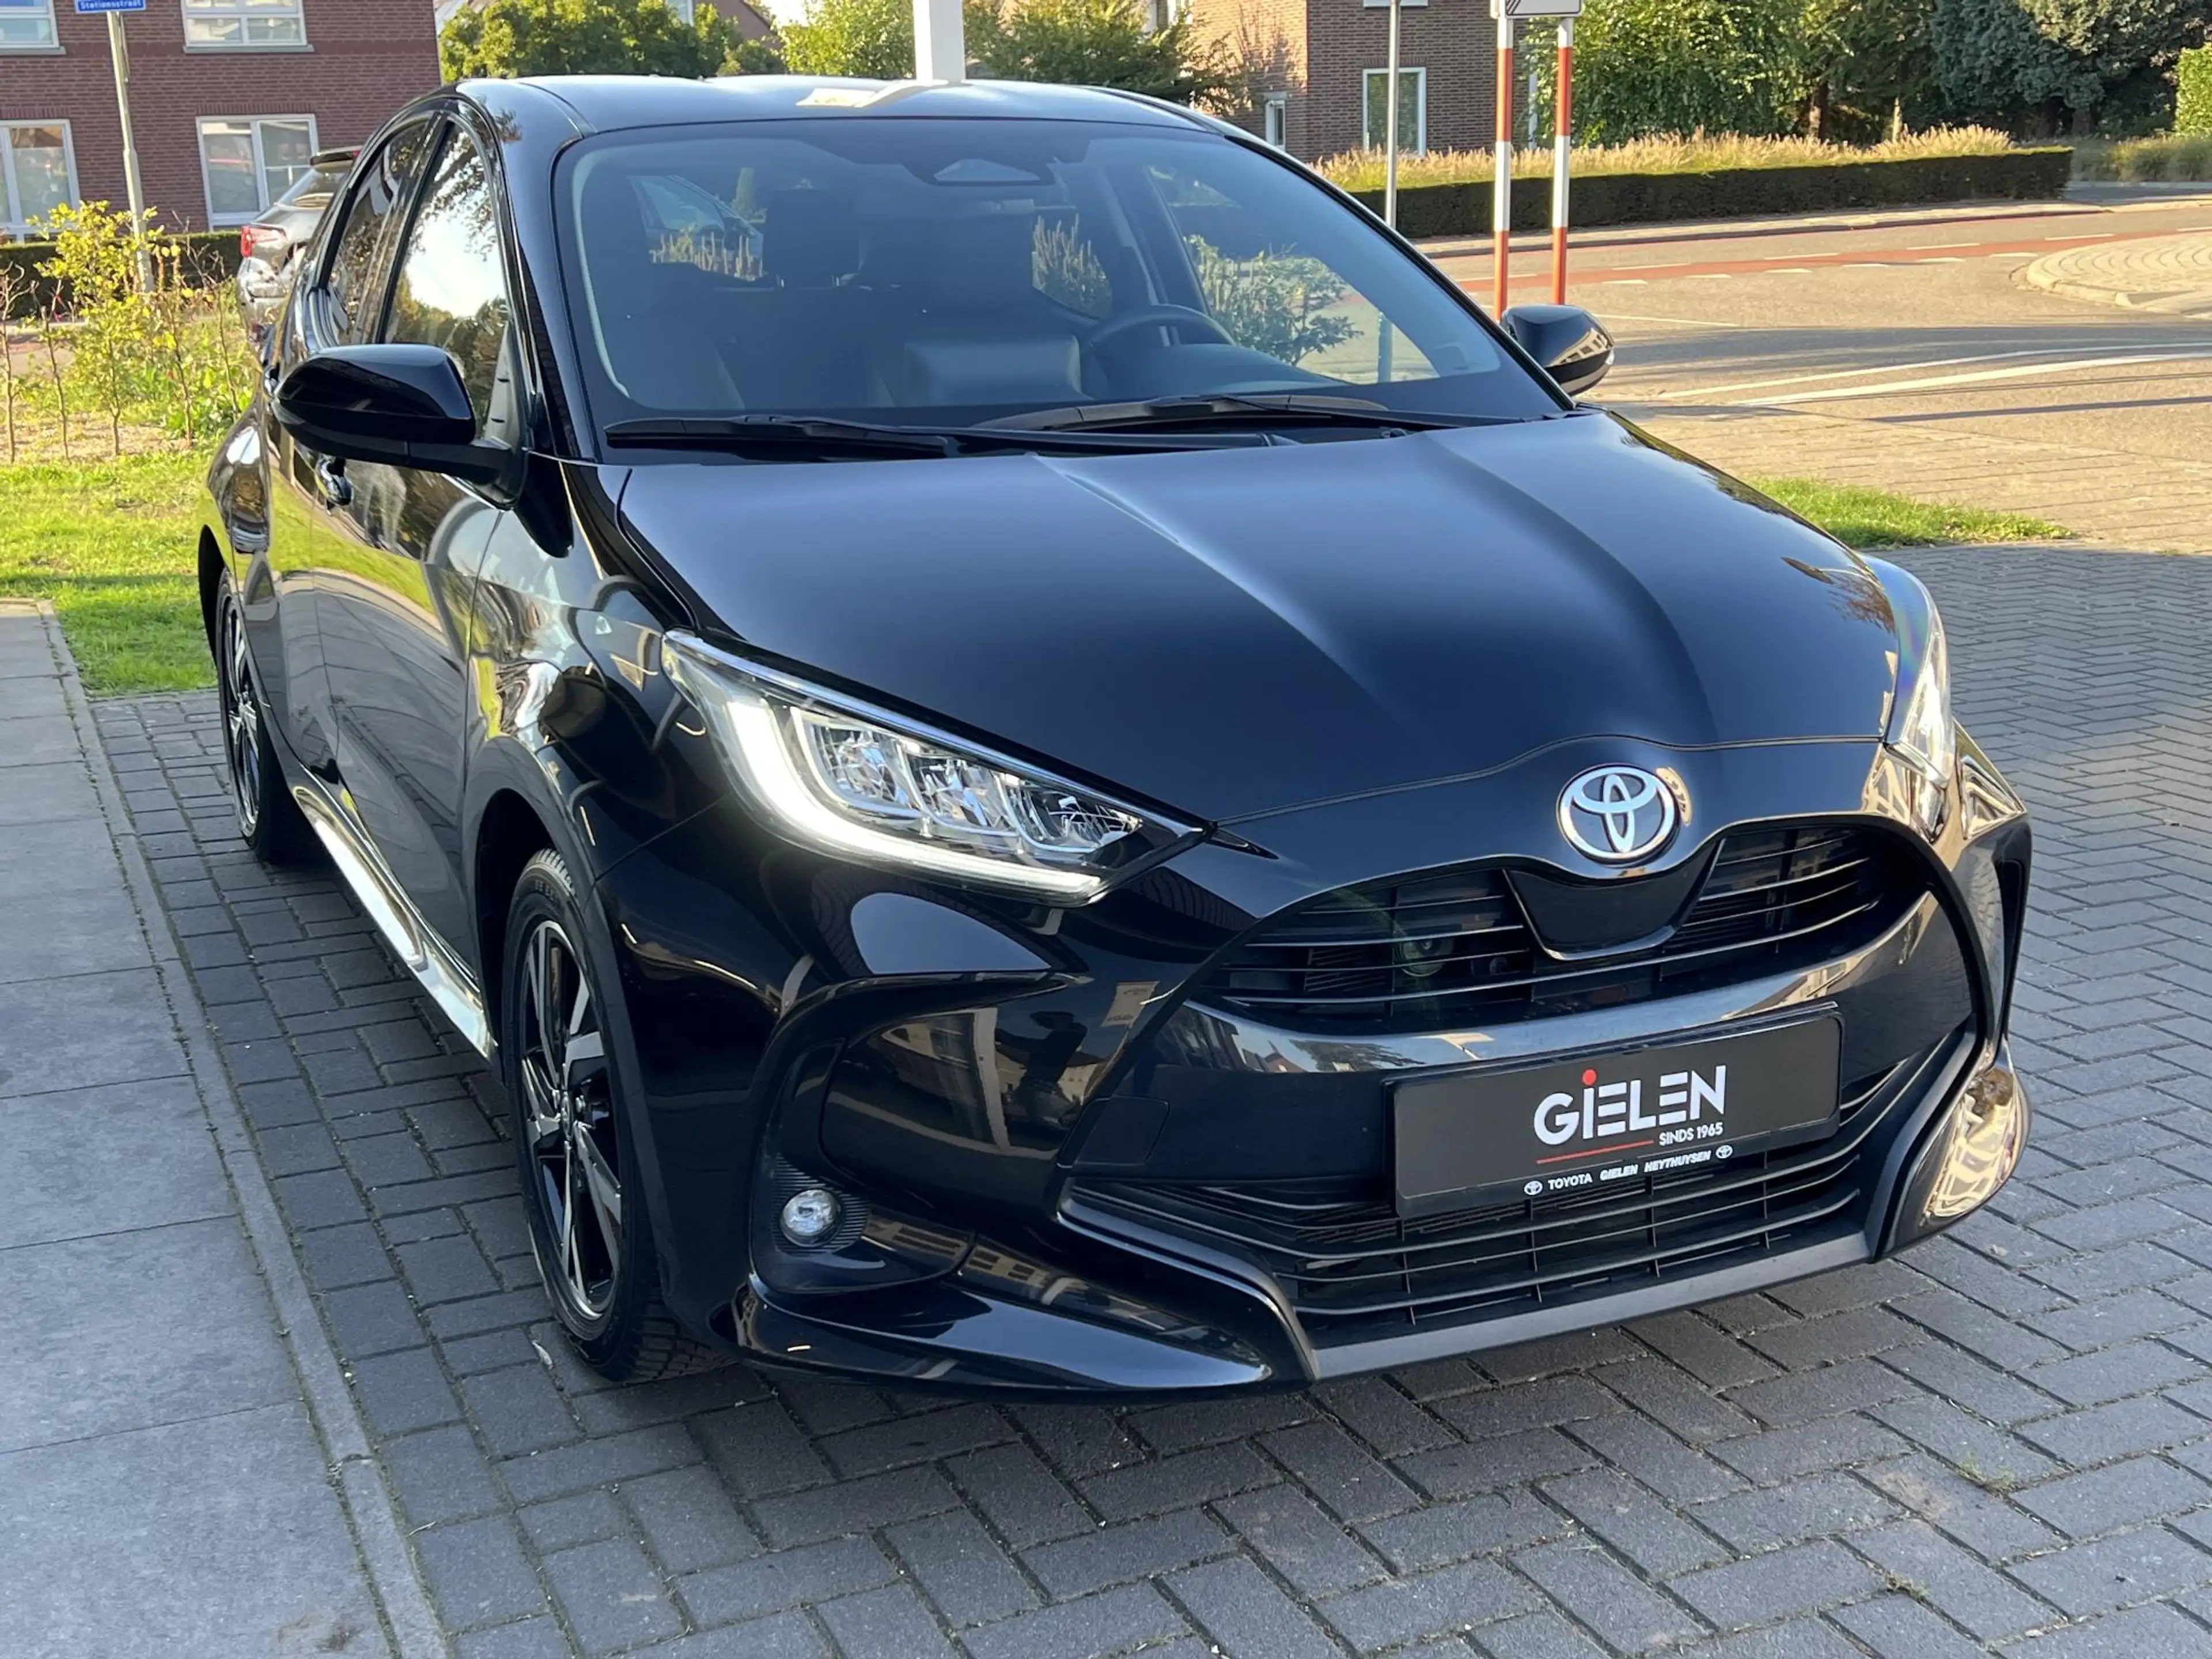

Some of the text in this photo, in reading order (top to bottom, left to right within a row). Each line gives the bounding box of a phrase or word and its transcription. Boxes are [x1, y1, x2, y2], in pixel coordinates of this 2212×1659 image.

[1659, 1122, 1724, 1146] SINDS 1965
[1548, 1150, 1712, 1190] TOYOTA GIELEN HEYTHUYSEN
